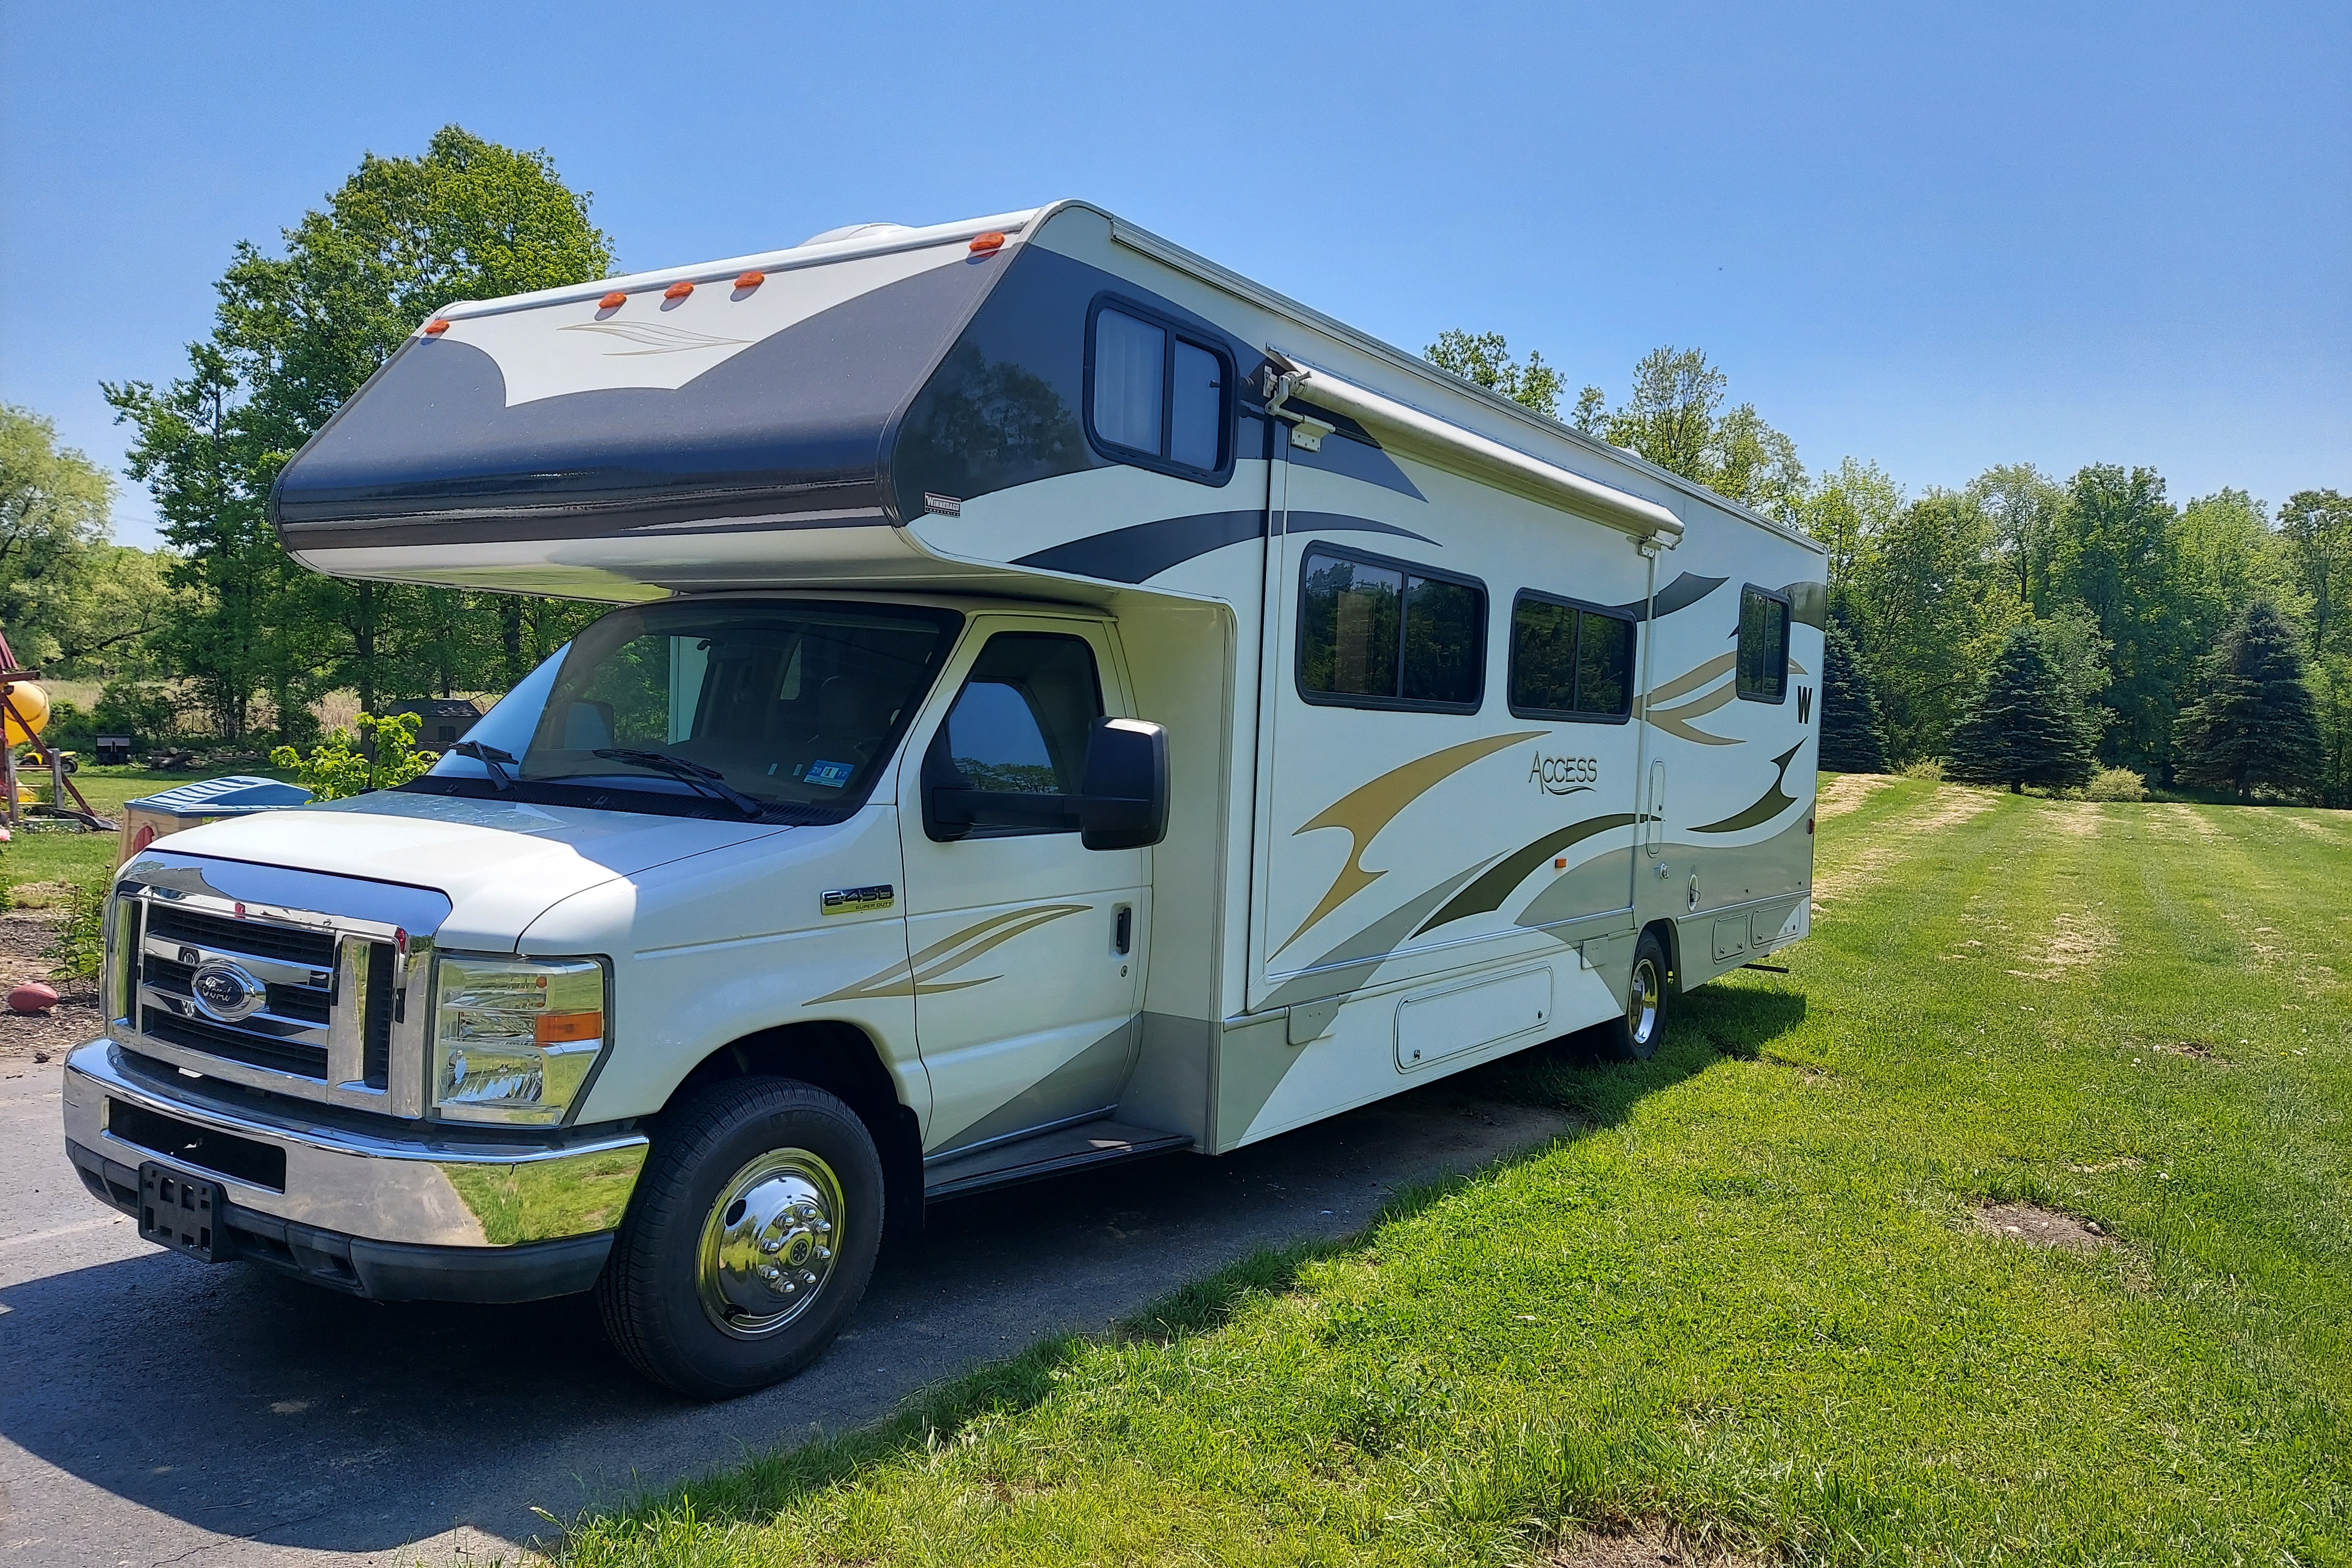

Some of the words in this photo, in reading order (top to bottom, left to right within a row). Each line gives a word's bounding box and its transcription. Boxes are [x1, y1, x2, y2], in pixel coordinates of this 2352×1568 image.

[1798, 685, 1813, 724] W
[825, 768, 833, 777] 1
[1528, 751, 1597, 794] ACCESS
[202, 976, 232, 1002] Ford
